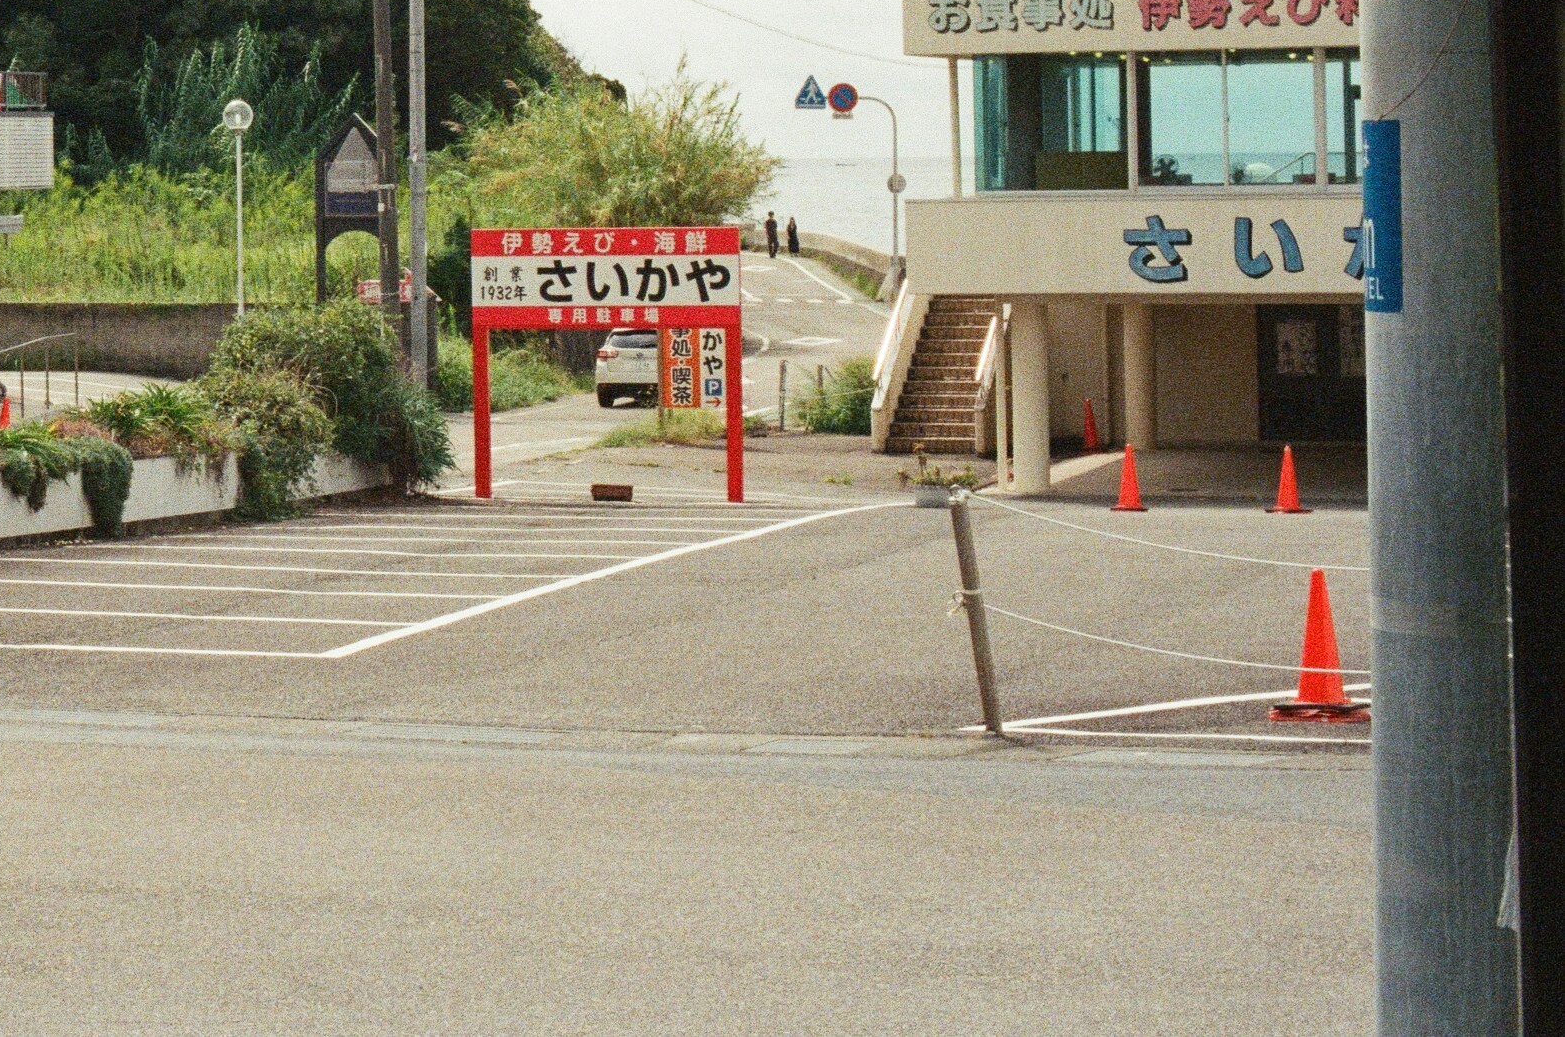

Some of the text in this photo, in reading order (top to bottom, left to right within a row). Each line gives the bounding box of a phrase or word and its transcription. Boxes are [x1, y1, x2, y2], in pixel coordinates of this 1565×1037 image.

[501, 231, 707, 254] 伊勢えび・海鮮
[483, 266, 523, 282] 創業
[536, 258, 731, 303] さいかや
[479, 284, 528, 301] 1932年
[548, 307, 660, 324] 専用駐車場
[702, 331, 723, 375] かや
